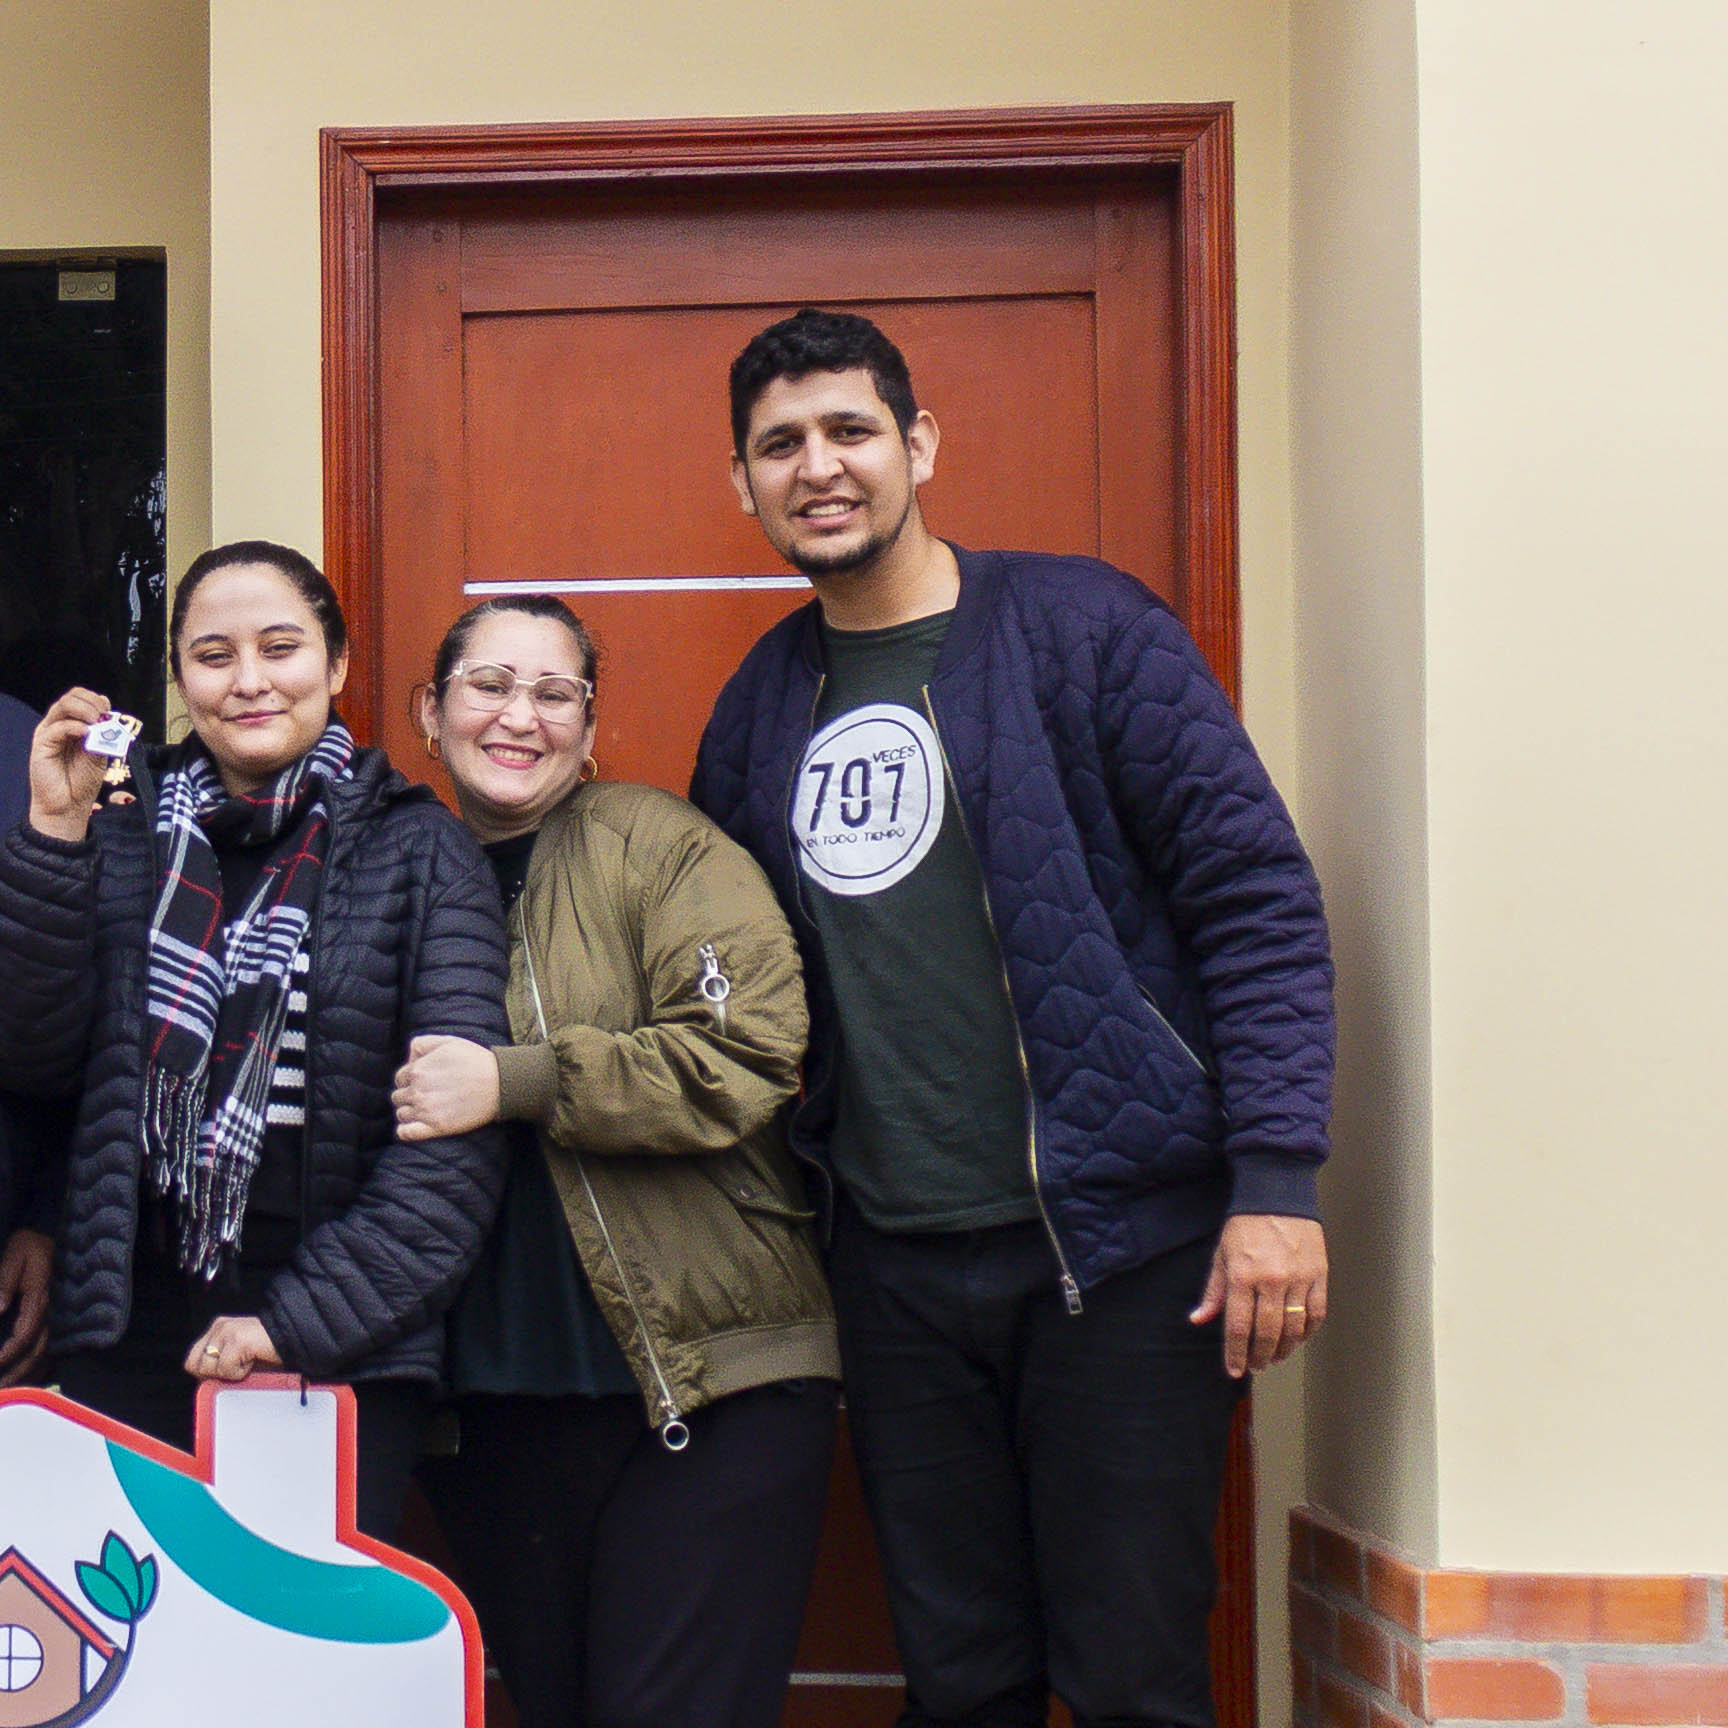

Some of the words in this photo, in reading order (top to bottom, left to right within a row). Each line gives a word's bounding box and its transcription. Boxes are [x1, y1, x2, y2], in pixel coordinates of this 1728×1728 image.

[872, 745, 917, 763] VECES
[823, 832, 858, 846] TODO
[864, 825, 906, 842] TIEMPO
